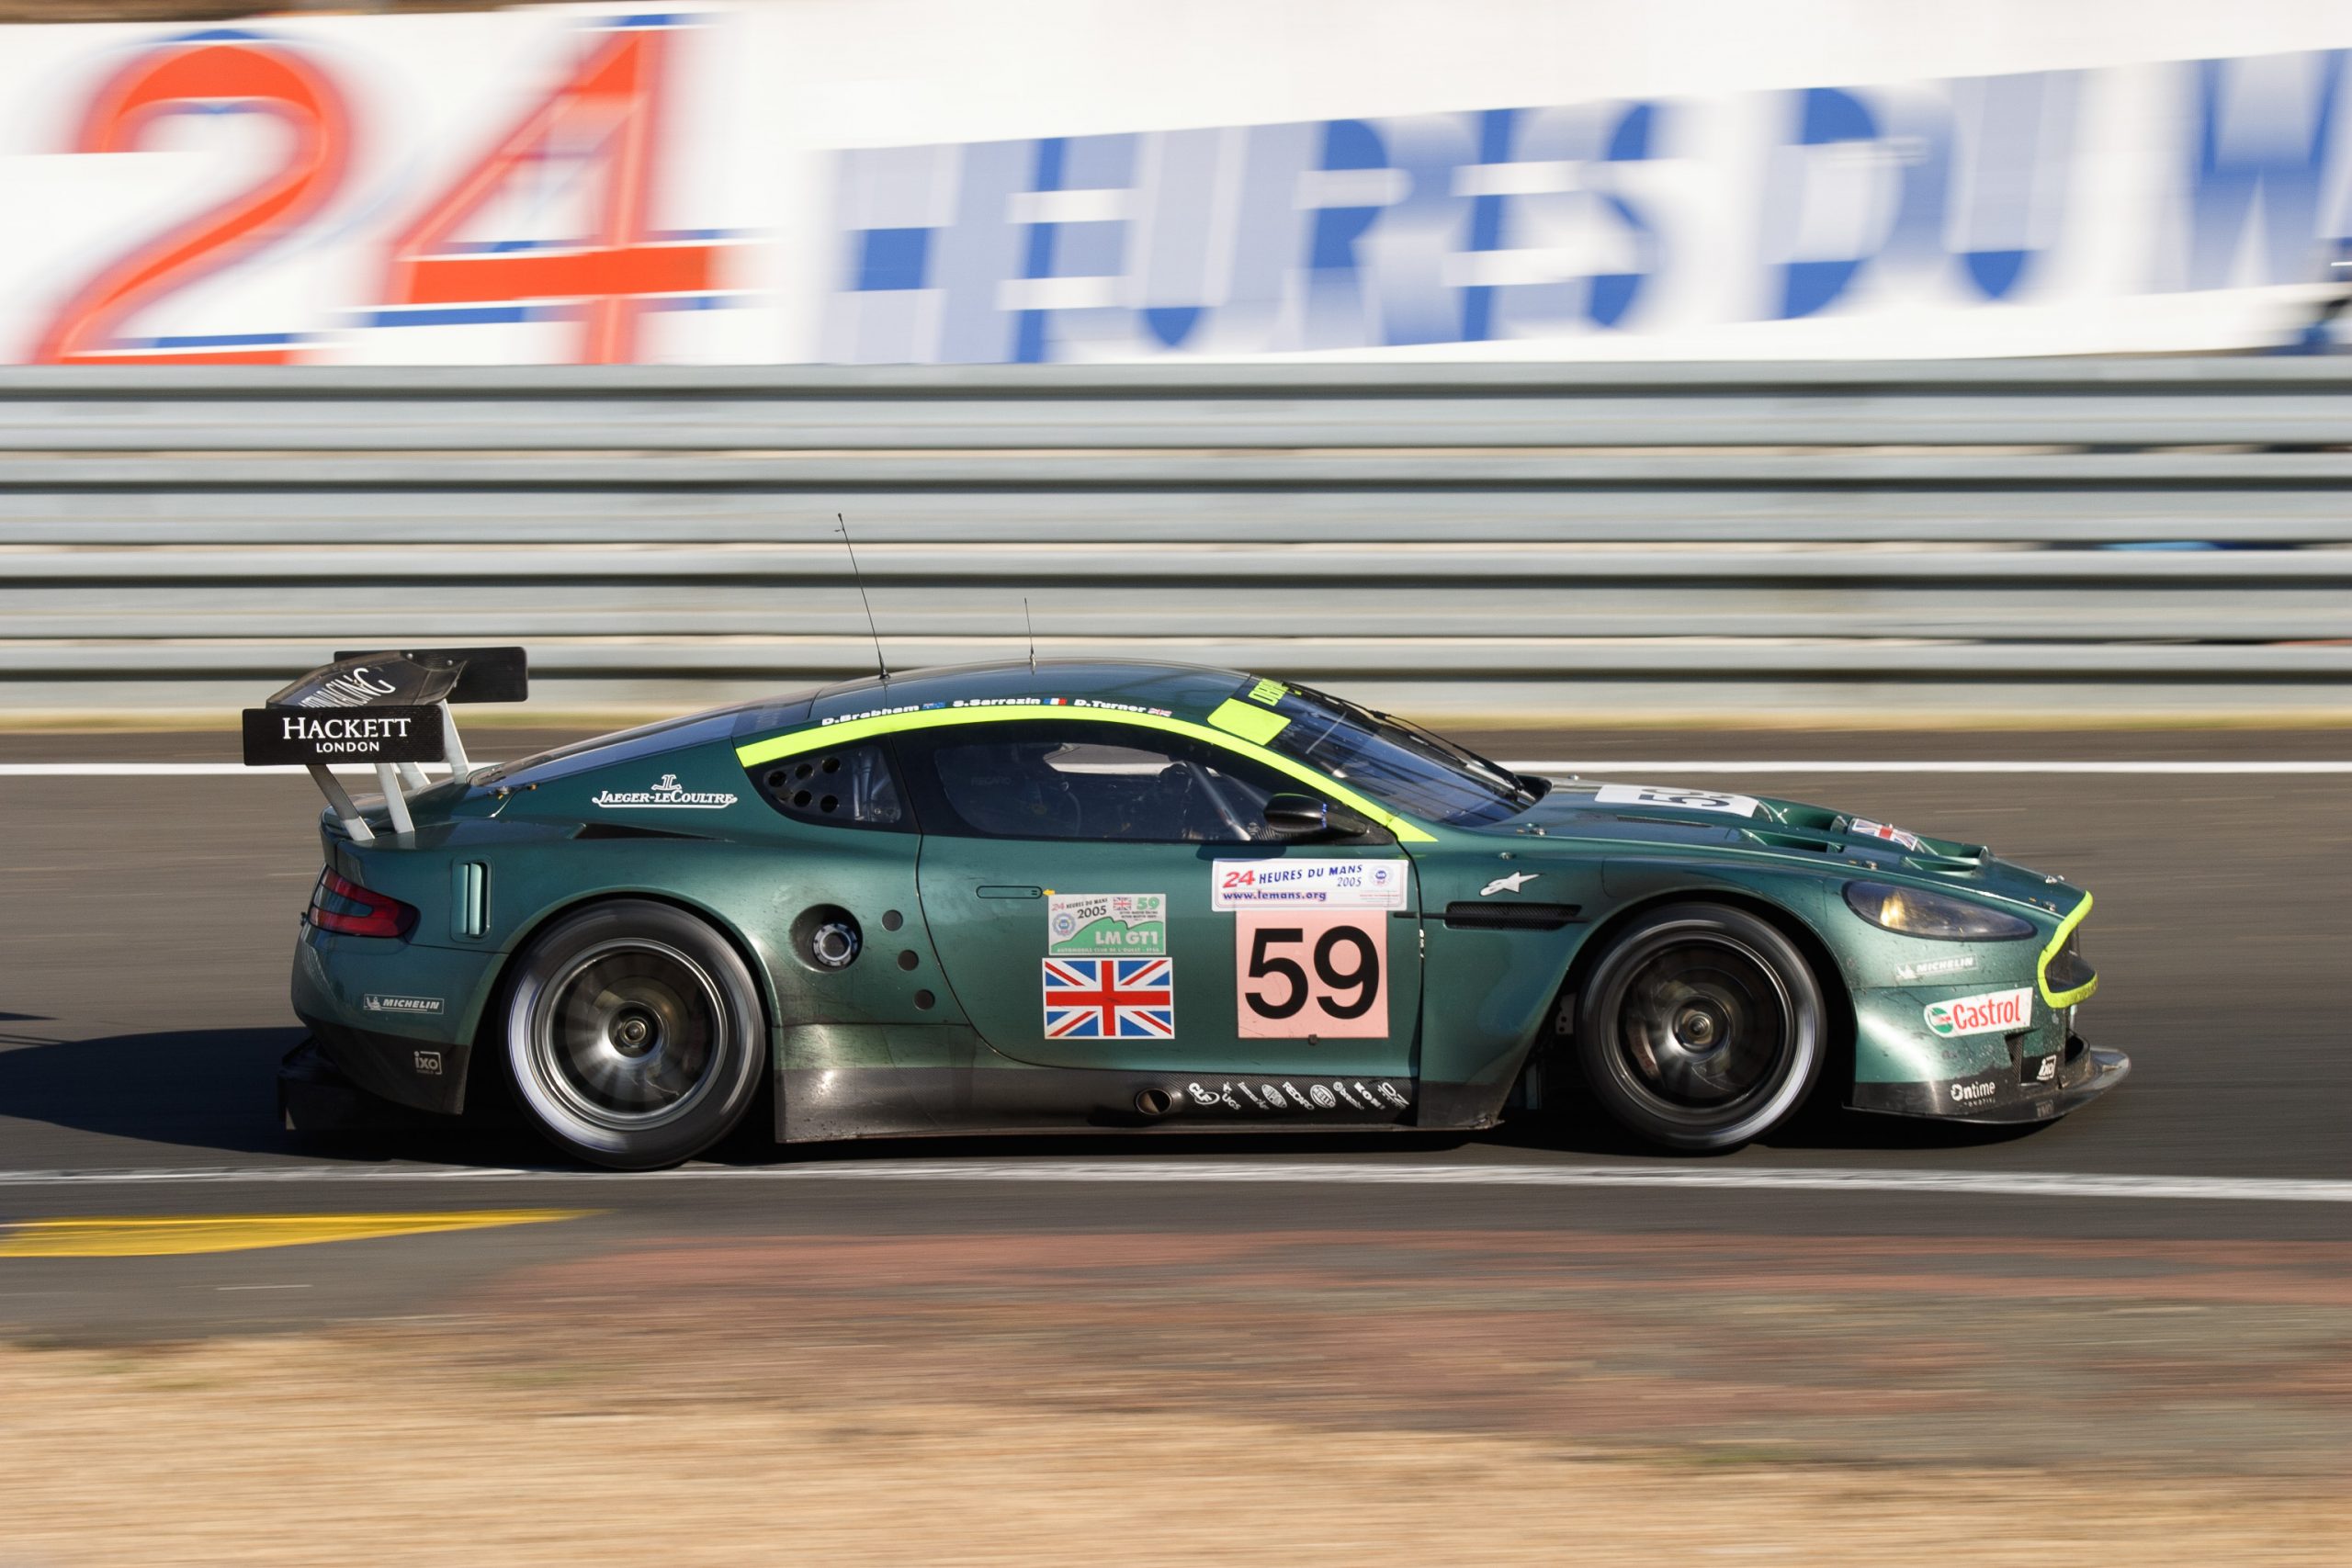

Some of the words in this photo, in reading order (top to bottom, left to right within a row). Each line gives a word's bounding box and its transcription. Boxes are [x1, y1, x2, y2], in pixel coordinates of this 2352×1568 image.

[32, 14, 726, 365] 24
[813, 98, 1668, 364] HEURES
[1759, 69, 2081, 320] DU
[821, 705, 919, 726] D.Brabham
[1073, 699, 1146, 713] D.Turner
[283, 716, 411, 739] HACKETT
[316, 741, 379, 753] LONDON
[1223, 870, 1255, 888] 24
[1259, 869, 1303, 884] HEURES
[1307, 868, 1324, 878] DU
[1329, 864, 1363, 876] MANS
[1337, 877, 1363, 887] 2005
[1066, 901, 1084, 909] HEURES
[1136, 897, 1159, 910] 59
[1223, 889, 1327, 902] www.lemans.org
[1077, 905, 1107, 919] 2005
[1095, 931, 1121, 945] LM
[1125, 931, 1158, 945] GT1
[1245, 925, 1379, 1020] 59
[1917, 957, 1973, 972] MICHELIN
[382, 998, 440, 1010] MICHELIN
[1952, 995, 2020, 1029] Castrol
[414, 1051, 438, 1070] ixo
[1189, 1082, 1212, 1102] CLF
[1283, 1081, 1314, 1110] RECARO
[1951, 1080, 1996, 1101] Ontime
